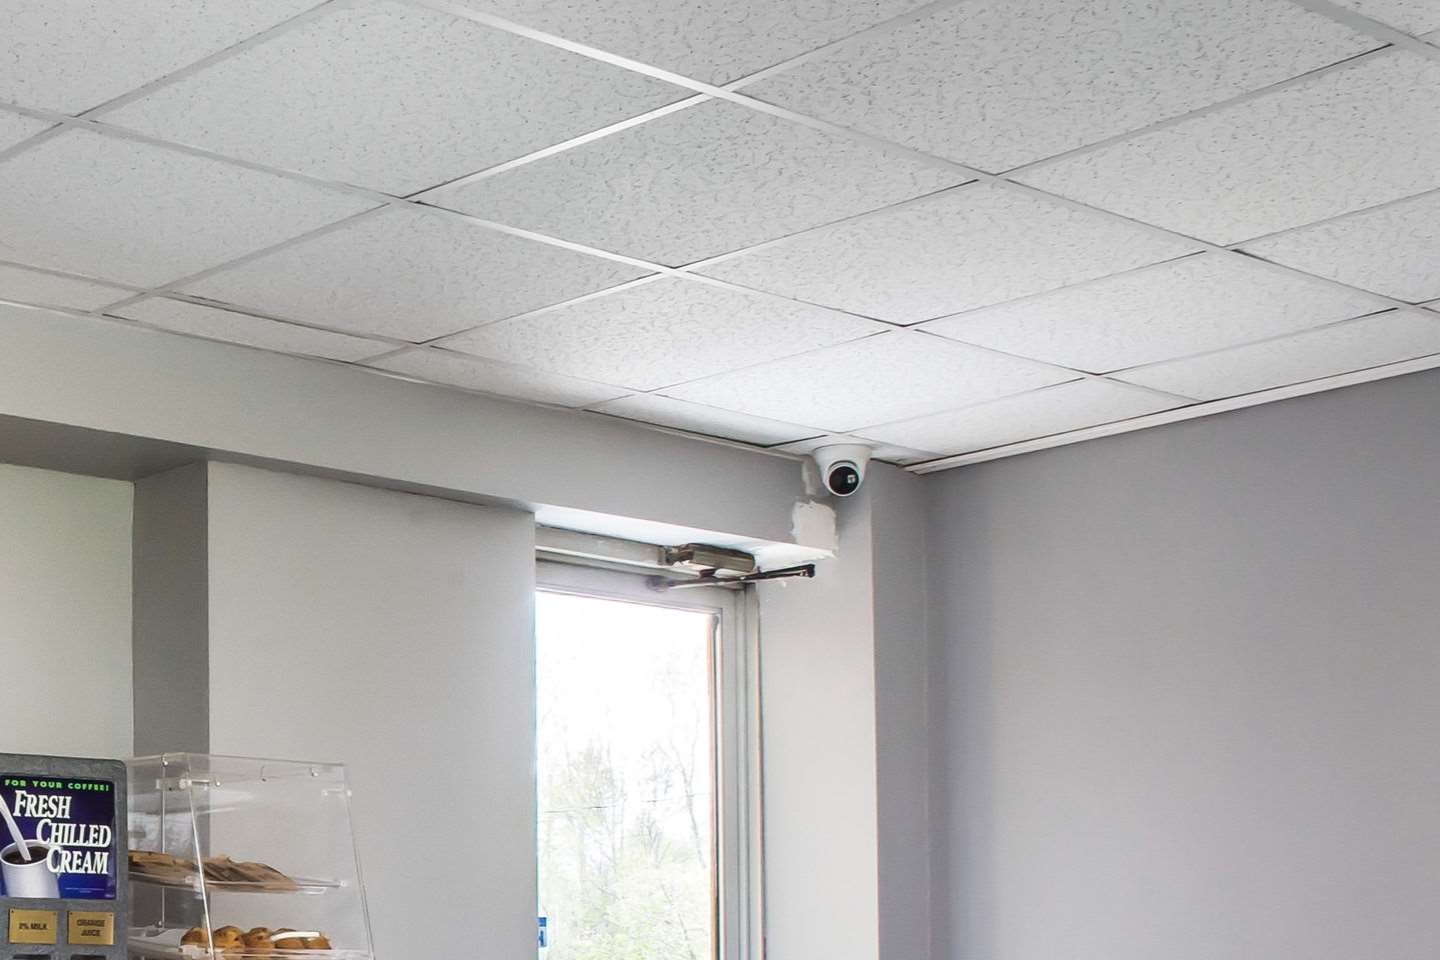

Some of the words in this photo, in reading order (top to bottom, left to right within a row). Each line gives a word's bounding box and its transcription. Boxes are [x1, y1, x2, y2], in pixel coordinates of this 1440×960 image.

[4, 779, 27, 787] FOR
[32, 780, 62, 789] YOUR
[68, 782, 110, 791] COFFEE!
[13, 790, 72, 818] FRESH
[36, 818, 112, 848] CHILLED
[46, 846, 109, 874] CREAM
[31, 922, 48, 930] MILK
